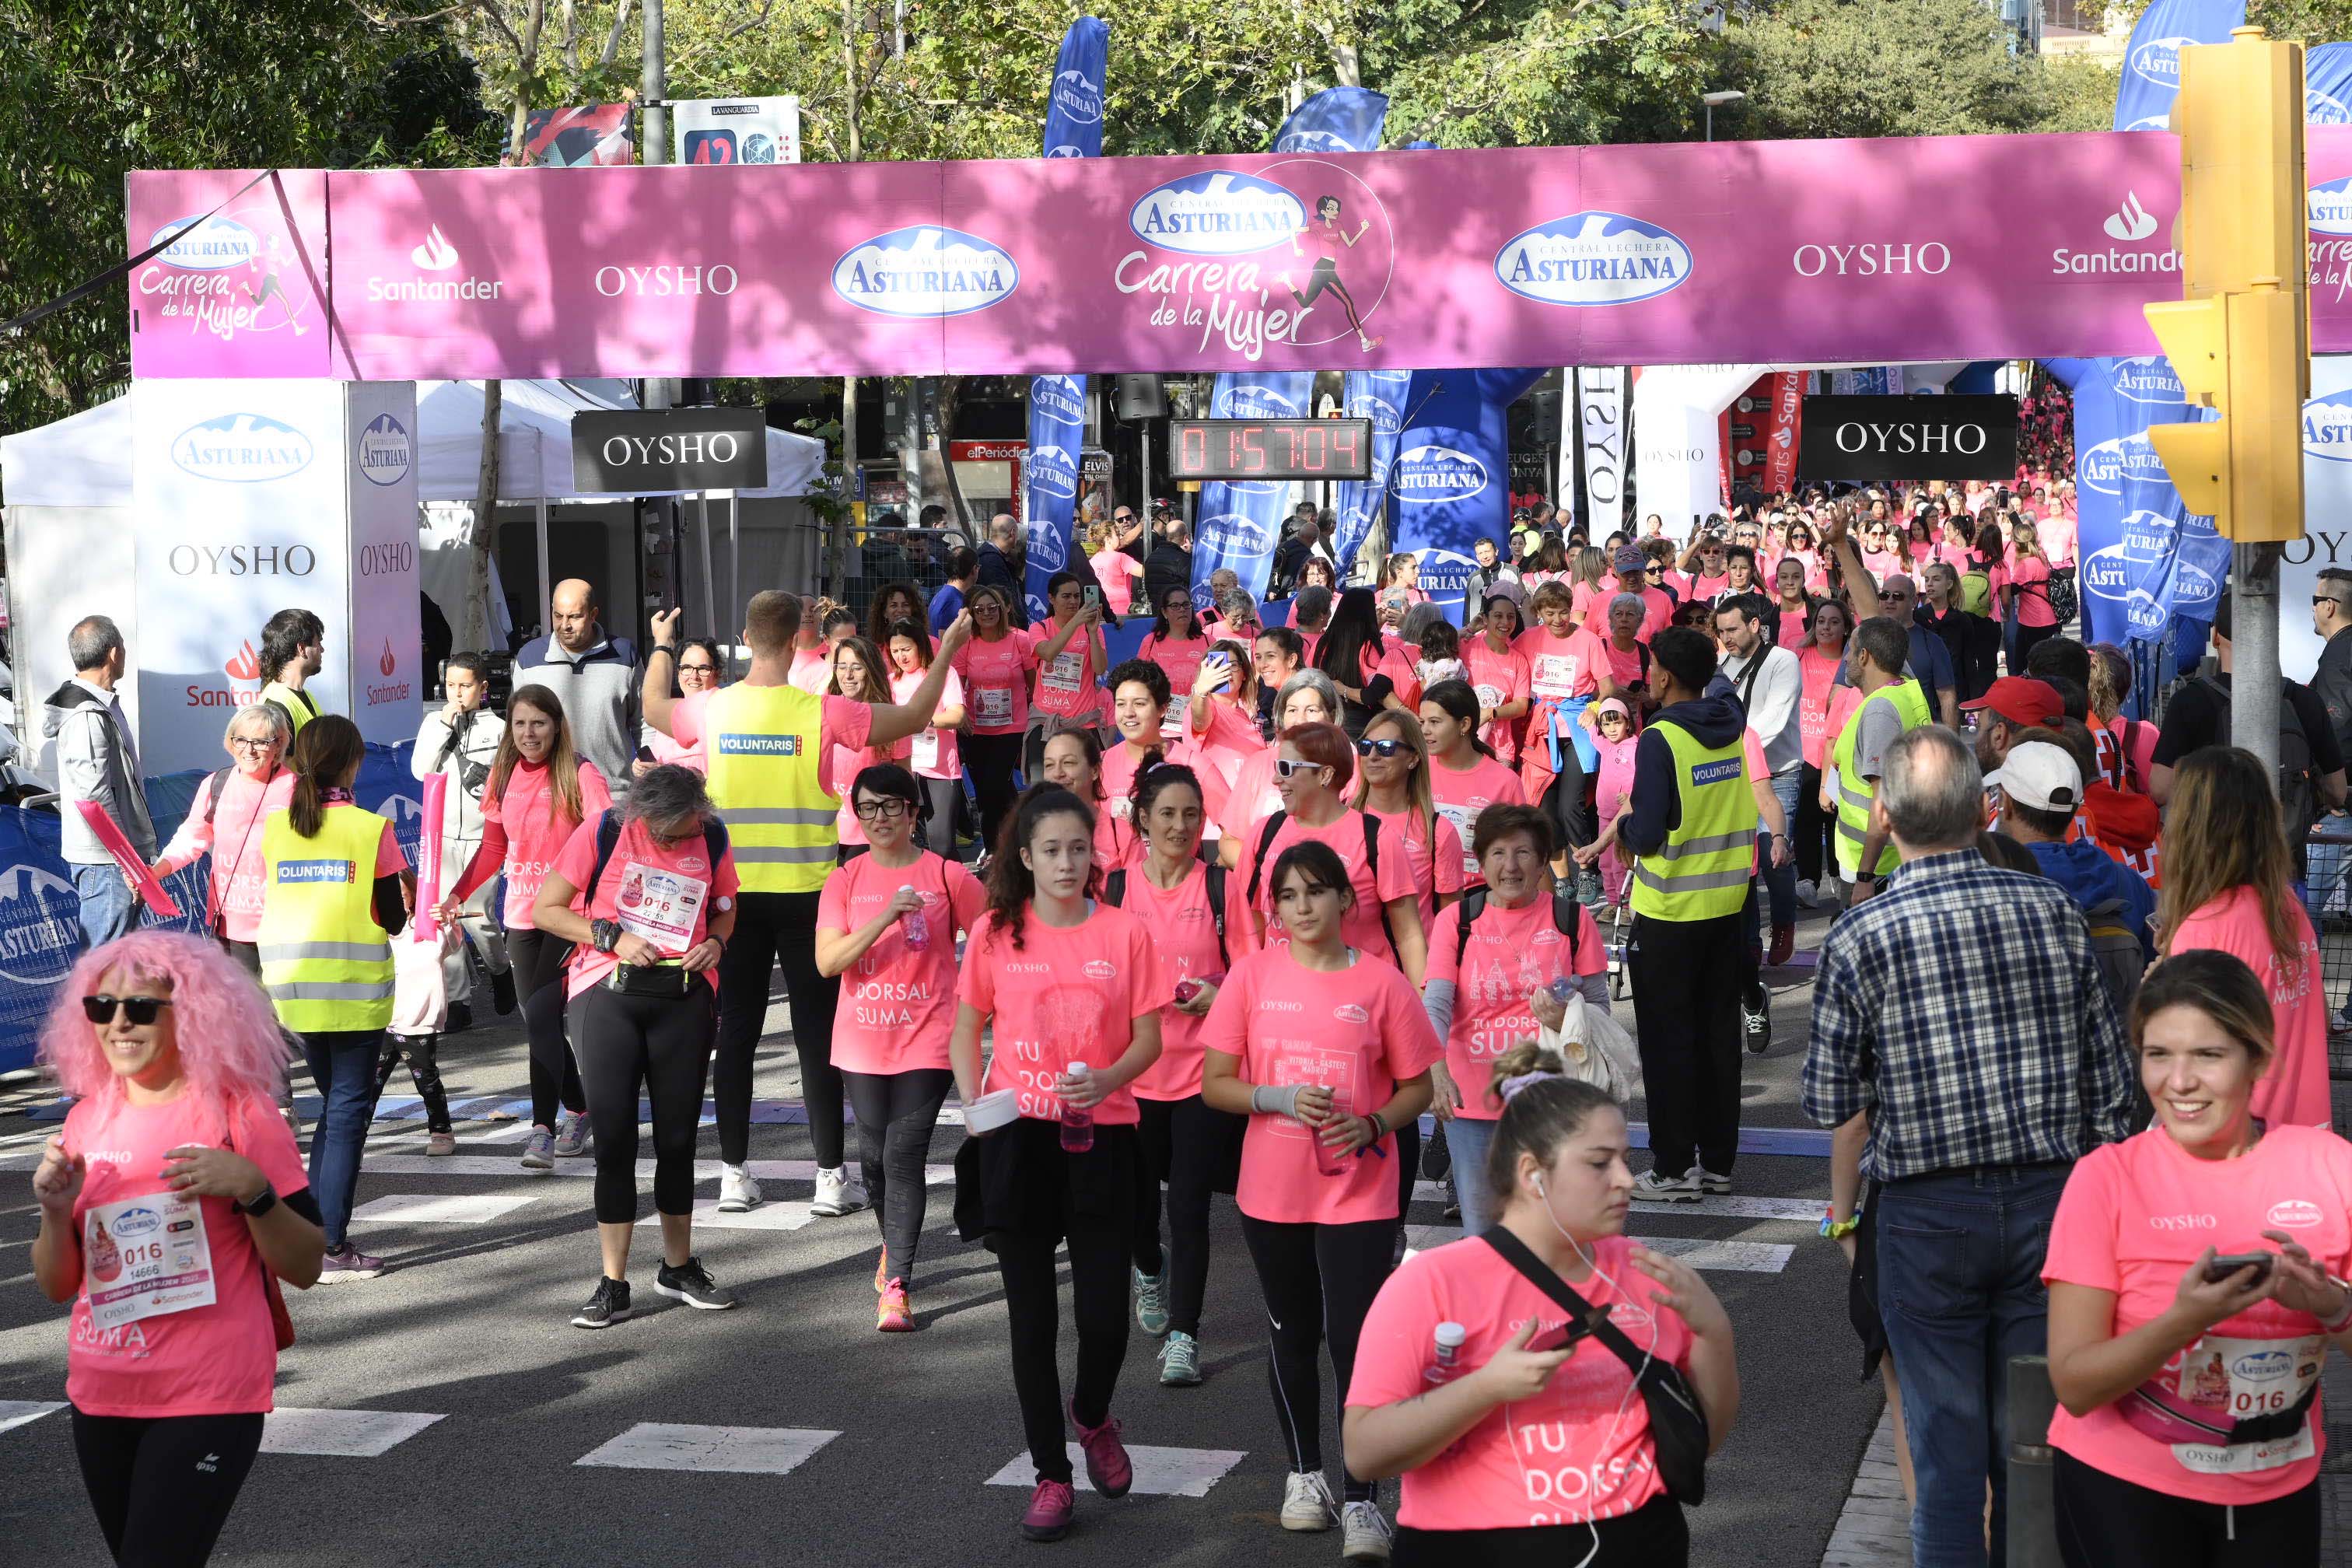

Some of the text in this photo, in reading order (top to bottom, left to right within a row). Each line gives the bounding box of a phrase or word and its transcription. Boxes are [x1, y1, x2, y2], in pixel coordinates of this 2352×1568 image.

[1143, 203, 1293, 233] ASTURIANA
[1539, 242, 1671, 255] CENTRAL LECHERA
[1793, 242, 1951, 277] OYSHO
[1115, 250, 1257, 294] Carrera
[1509, 247, 1677, 283] ASTURIANA
[2325, 263, 2340, 285] la
[139, 266, 229, 296] Carrera
[368, 275, 503, 300] Santander
[595, 264, 738, 297] OYSHO
[847, 261, 1005, 293] ASTURIANA
[162, 293, 265, 341] de la Mujer
[1150, 289, 1314, 361] de la Mujer
[1836, 422, 1986, 454] OYSHO
[184, 439, 303, 465] ASTURIANA
[363, 441, 411, 468] ASTURIANA
[603, 433, 738, 467] OYSHO
[1084, 461, 1109, 471] ELVIS
[1392, 471, 1480, 490] ASTURIANA
[169, 544, 317, 576] OYSHO
[360, 541, 411, 577] OYSHO
[367, 682, 410, 706] Santander
[1042, 695, 1072, 706] SUMA
[1802, 712, 1825, 723] DOR
[720, 739, 793, 751] VOLUNTARIS
[1693, 759, 1741, 782] VOLUNTARIS
[621, 851, 653, 865] OYSHO
[278, 866, 346, 878] VOLUNTARIS
[644, 897, 671, 912] 016
[851, 894, 884, 904] OYSHO
[642, 909, 664, 921] 2255
[1006, 963, 1050, 973] OYSHO
[857, 982, 930, 1001] DORSAL
[856, 1006, 913, 1025] SUMA
[1261, 1001, 1303, 1013] OYSHO
[1015, 1040, 1041, 1062] TU
[2151, 1213, 2217, 1230] OYSHO
[124, 1242, 163, 1265] 016
[103, 1290, 205, 1320] OYSHO Santander
[75, 1314, 148, 1349] SUMA
[2236, 1390, 2284, 1412] 016
[1517, 1420, 1566, 1455] TU
[2186, 1447, 2235, 1463] OYSHO
